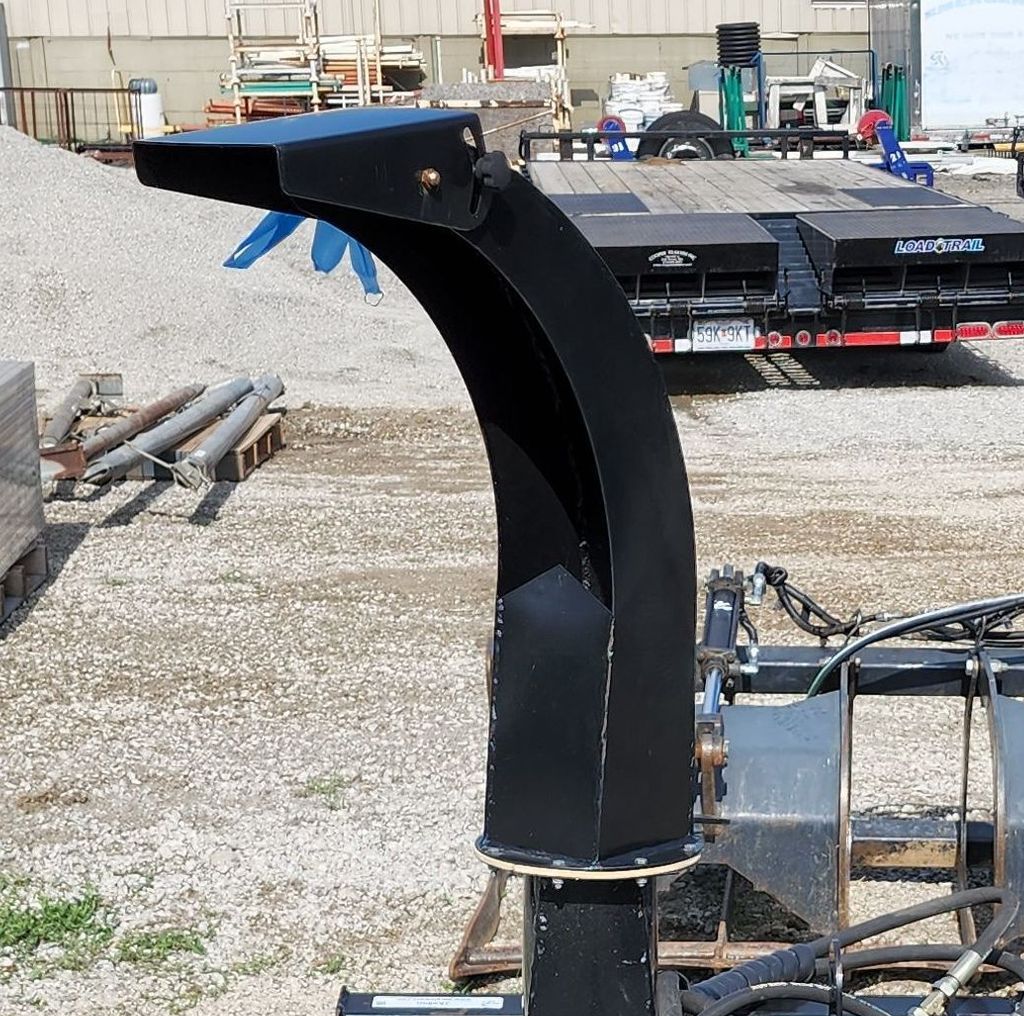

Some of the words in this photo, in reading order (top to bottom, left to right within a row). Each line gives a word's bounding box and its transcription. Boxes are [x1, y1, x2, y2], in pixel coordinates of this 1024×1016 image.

[894, 240, 935, 254] LOAD
[942, 239, 985, 252] TRAIL
[697, 325, 720, 342] 59K
[727, 325, 751, 342] 9KT
